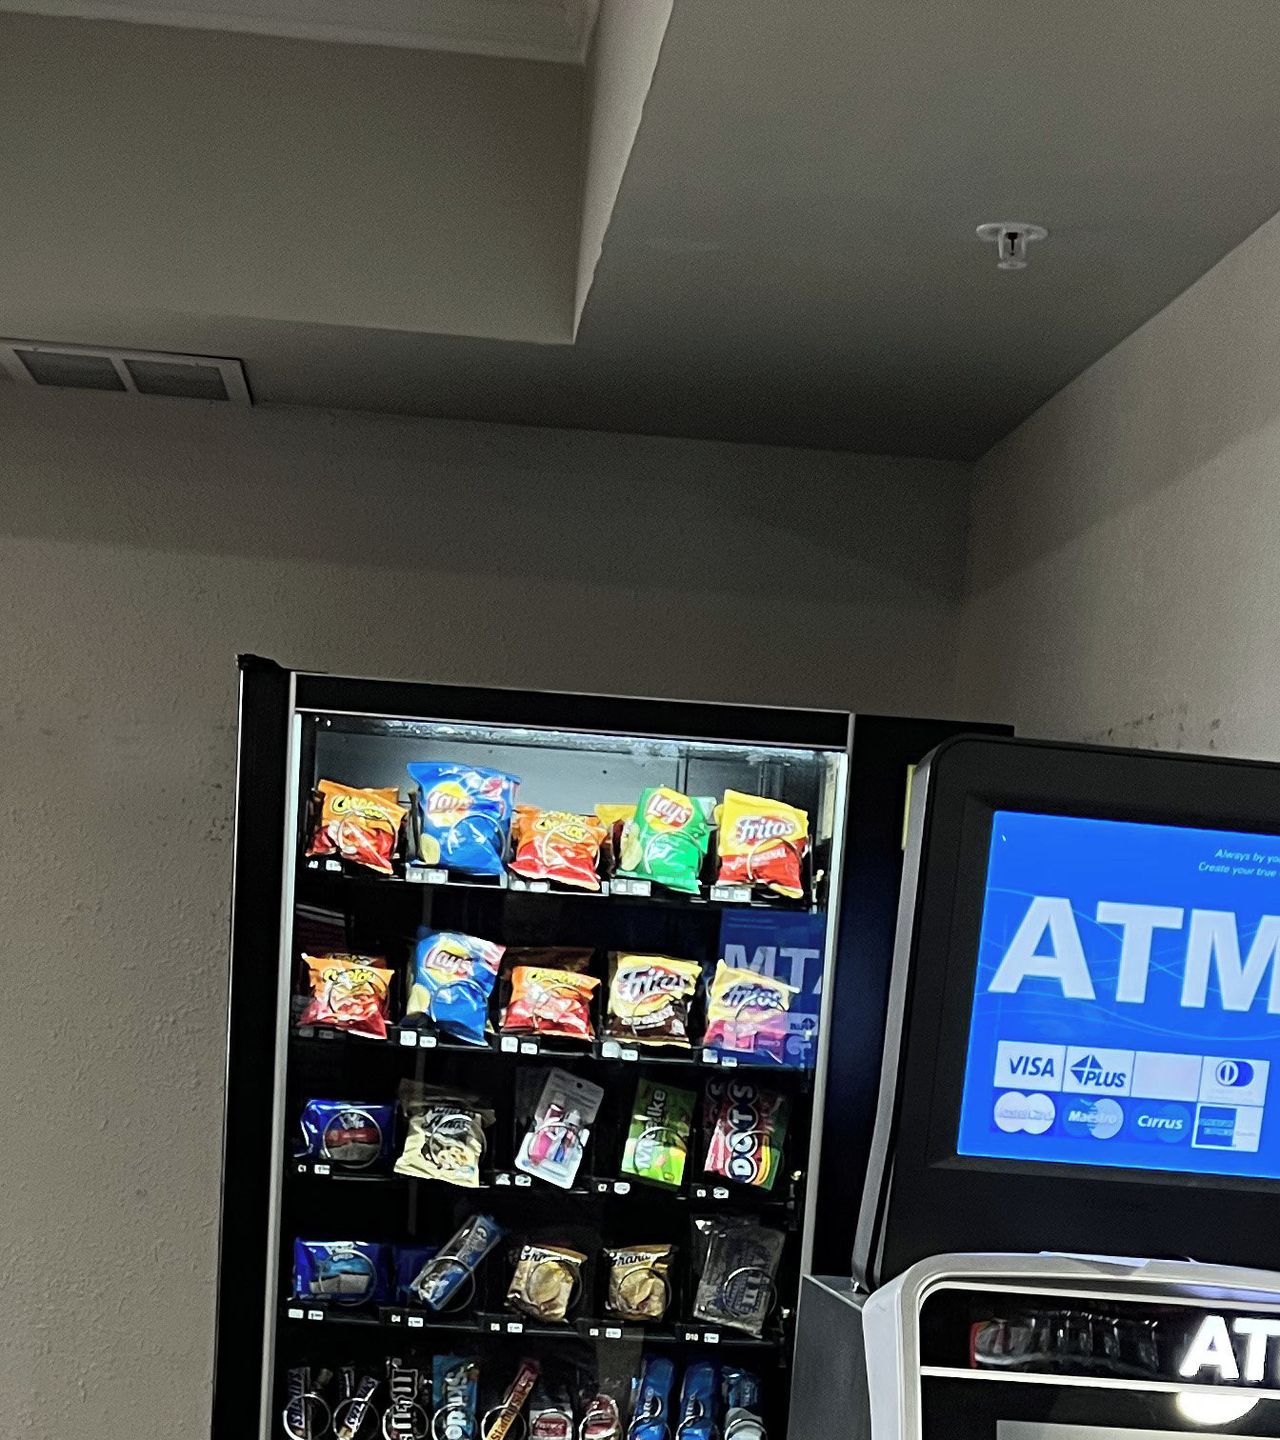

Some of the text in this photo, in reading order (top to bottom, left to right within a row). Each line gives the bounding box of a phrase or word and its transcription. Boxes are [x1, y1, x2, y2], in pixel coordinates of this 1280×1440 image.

[734, 815, 796, 842] Fritos
[1215, 849, 1250, 861] Always
[1253, 853, 1265, 863] by
[1199, 861, 1230, 873] Create
[1232, 867, 1254, 876] your
[1256, 868, 1277, 877] true
[1009, 1055, 1126, 1088] VISA PLUS
[1137, 1115, 1183, 1130] Cirrus
